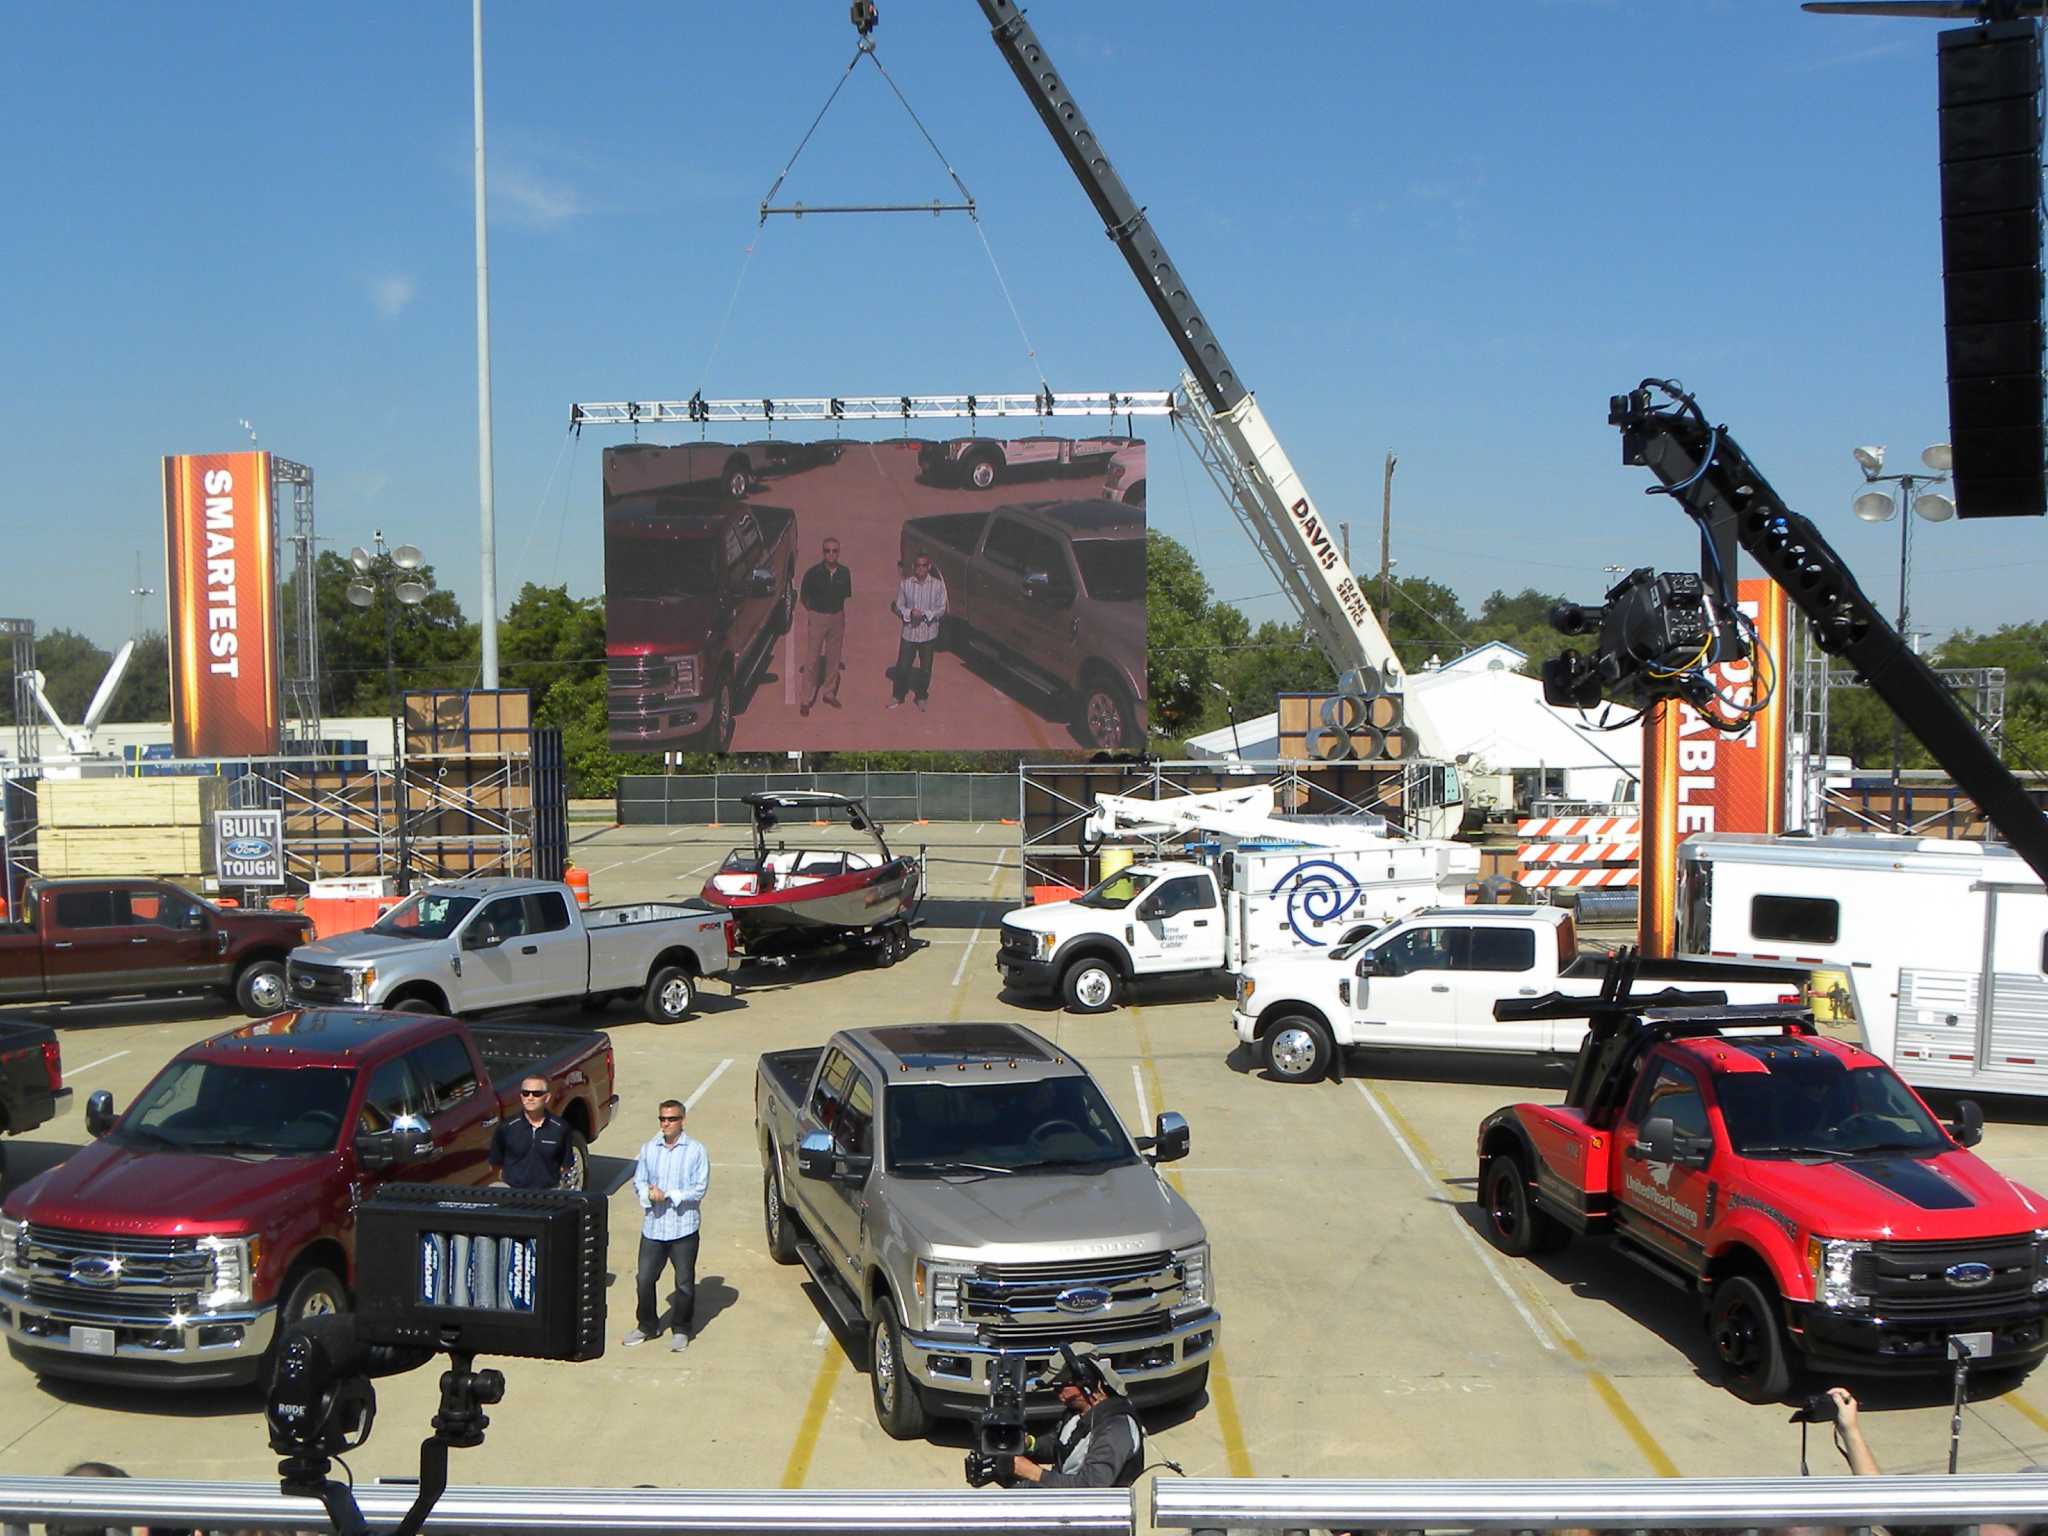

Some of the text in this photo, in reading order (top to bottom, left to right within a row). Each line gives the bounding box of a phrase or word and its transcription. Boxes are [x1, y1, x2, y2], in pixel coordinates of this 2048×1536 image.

[1291, 497, 1339, 571] DAVIS
[203, 468, 240, 679] SMARTEST
[1343, 577, 1368, 615] CRANE
[1336, 583, 1364, 627] SERVICE
[222, 818, 275, 837] BUILT
[223, 860, 277, 876] TOUGH
[424, 1241, 433, 1299] RAYOVAC
[513, 1241, 523, 1300] RAYOVAC
